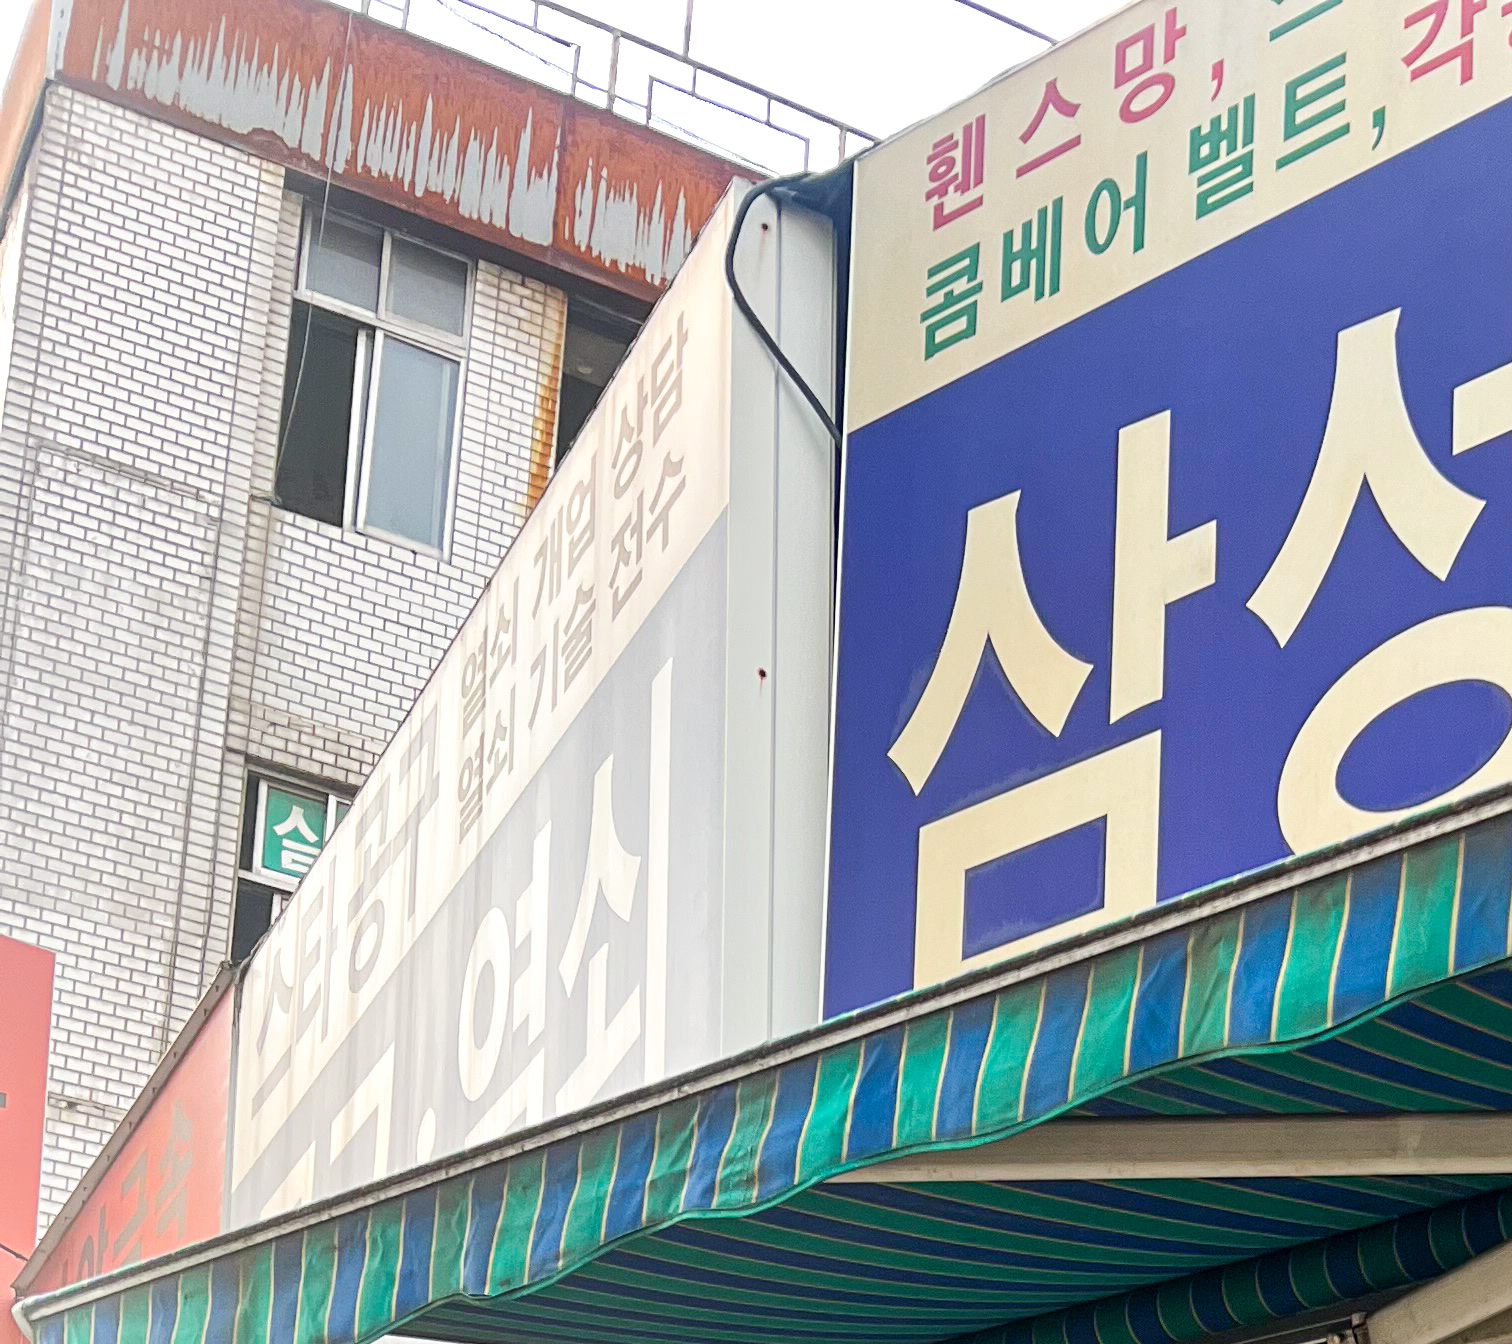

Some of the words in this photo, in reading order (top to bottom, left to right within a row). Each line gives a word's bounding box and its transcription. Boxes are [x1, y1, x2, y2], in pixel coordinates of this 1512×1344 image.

[458, 683, 516, 845] 열쇠
[528, 581, 598, 731] 기술
[608, 450, 687, 623] 전수
[461, 576, 519, 741] 열쇠
[532, 449, 598, 620] 개업
[611, 310, 689, 500] 상담
